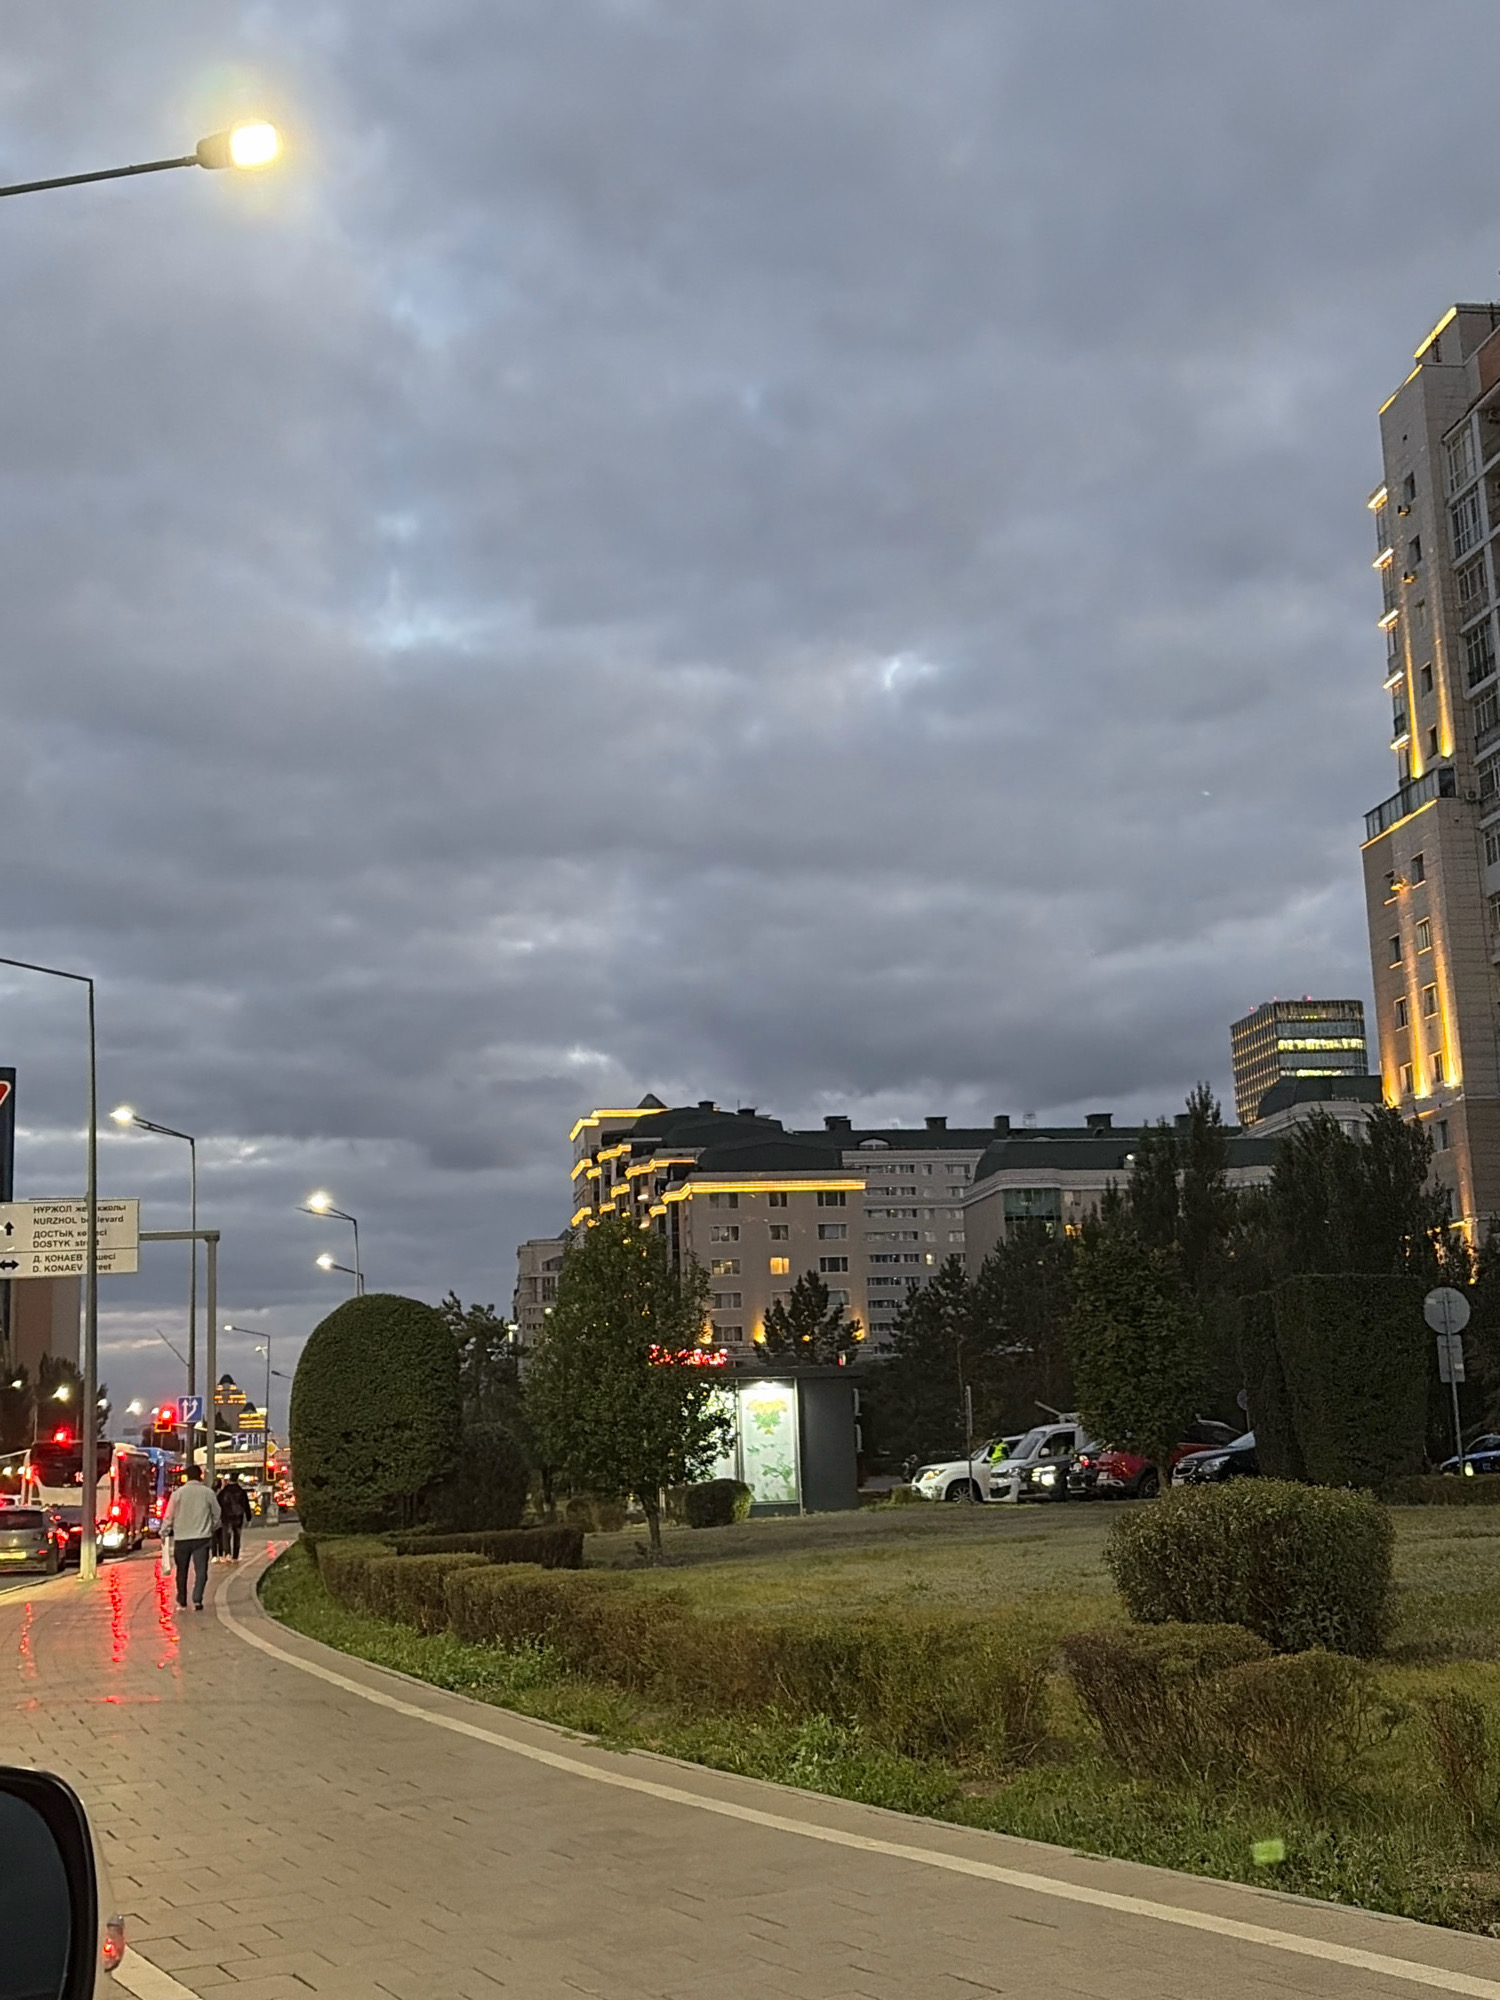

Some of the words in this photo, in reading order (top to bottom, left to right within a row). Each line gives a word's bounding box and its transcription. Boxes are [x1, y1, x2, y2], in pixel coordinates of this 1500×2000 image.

[75, 1205, 126, 1213] жекжолы
[33, 1216, 77, 1225] NURZHOL
[33, 1230, 73, 1240] ДОСТЫҚ
[33, 1240, 71, 1249] DOSTYK
[75, 1238, 100, 1247] strt
[44, 1253, 83, 1263] ҚОНАЕВ
[32, 1265, 41, 1273] D.
[44, 1263, 83, 1273] KONAEV
